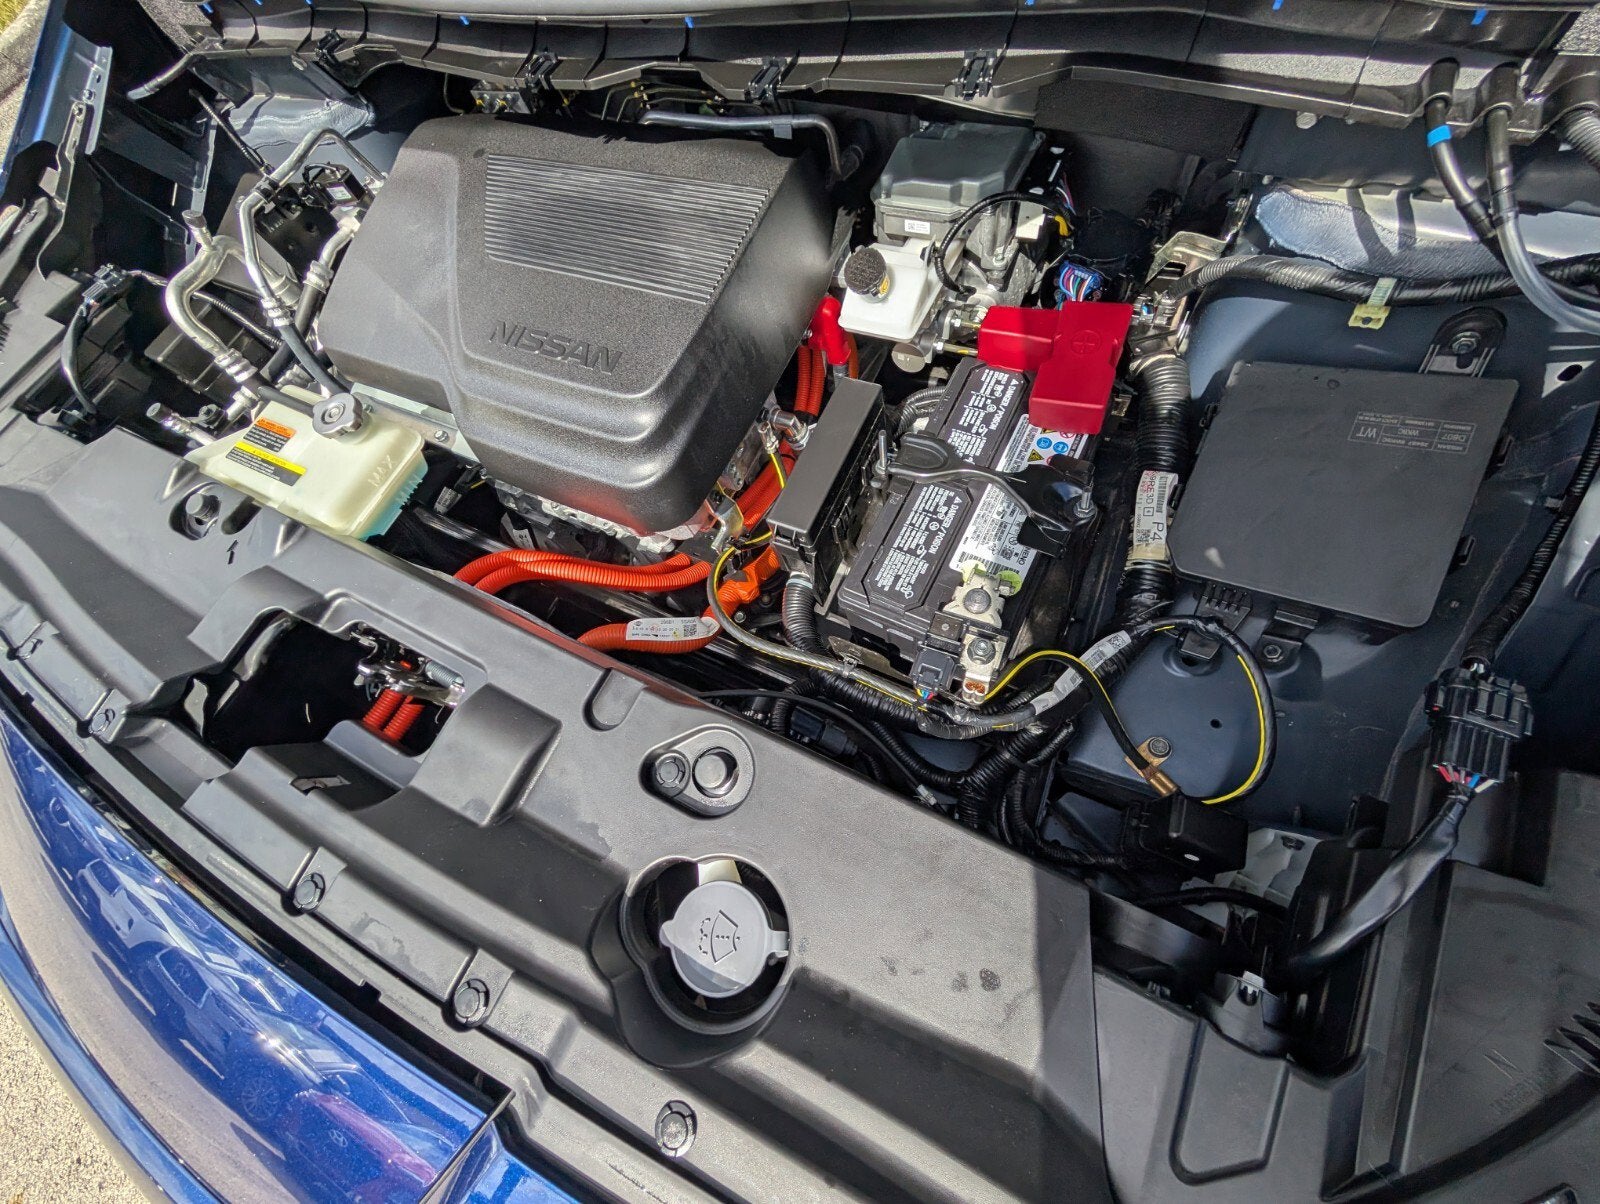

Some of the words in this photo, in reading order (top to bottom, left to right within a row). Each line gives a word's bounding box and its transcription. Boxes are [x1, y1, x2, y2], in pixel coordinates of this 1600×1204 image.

[489, 320, 623, 376] NISSAN
[1356, 426, 1378, 438] WT
[368, 454, 394, 487] MAX
[1150, 521, 1164, 541] P4
